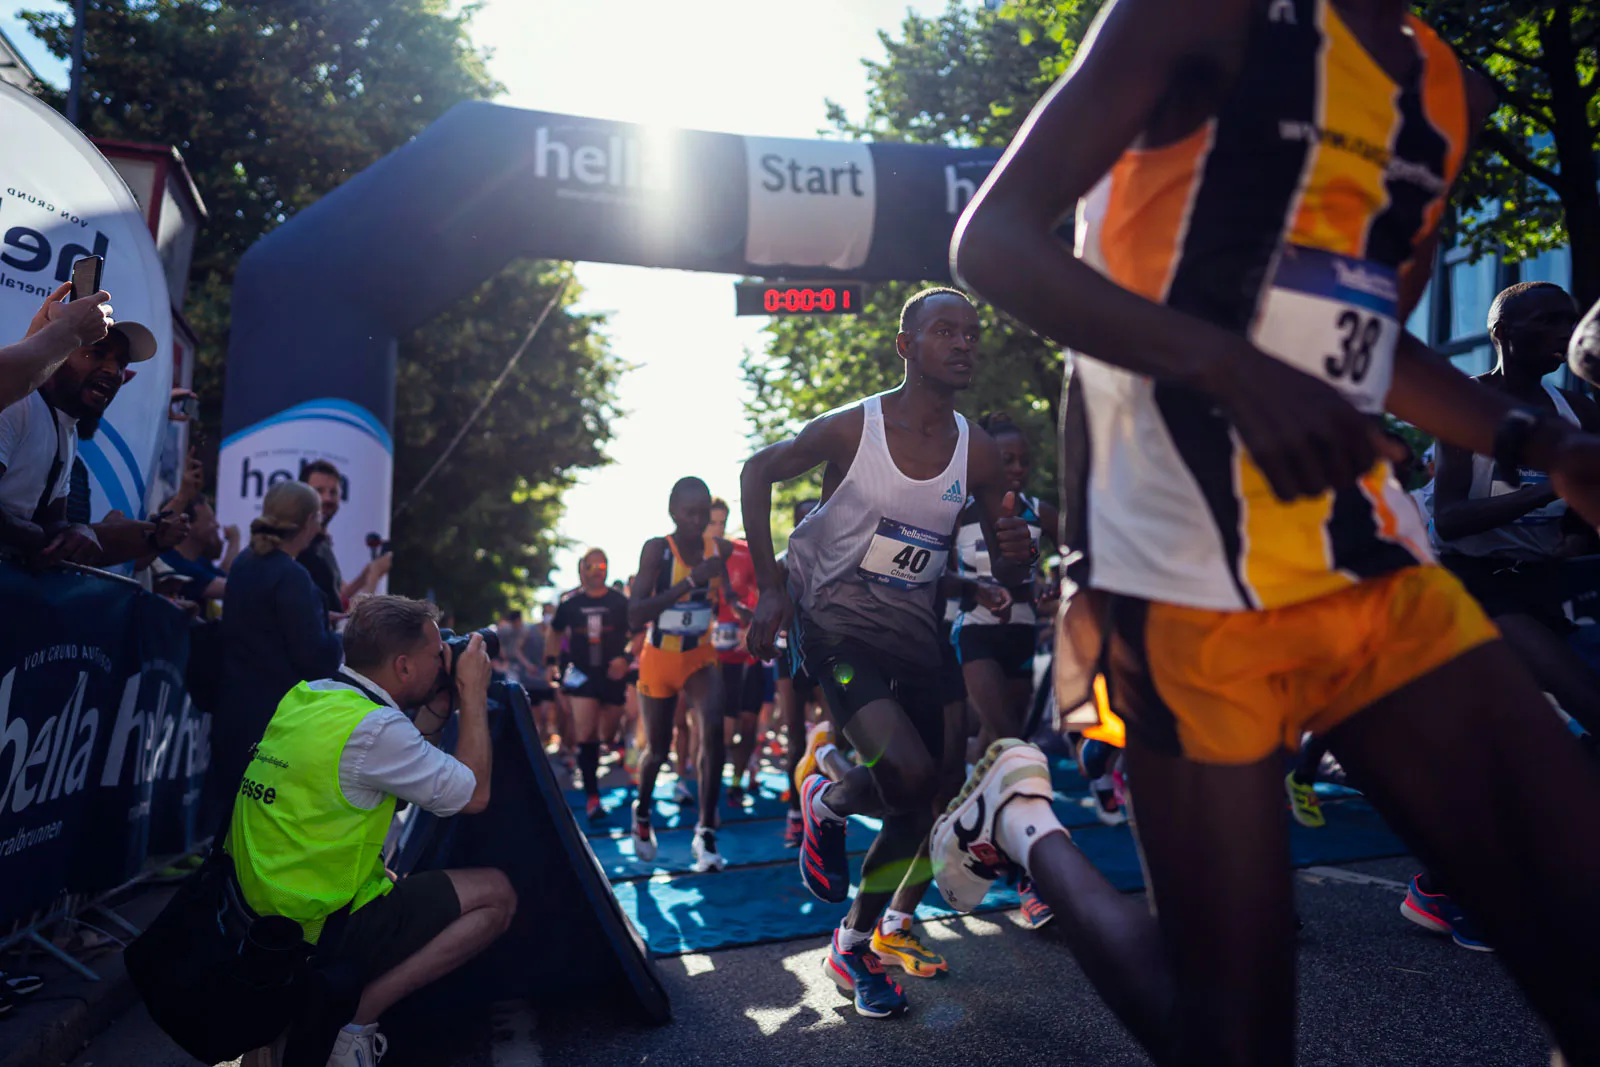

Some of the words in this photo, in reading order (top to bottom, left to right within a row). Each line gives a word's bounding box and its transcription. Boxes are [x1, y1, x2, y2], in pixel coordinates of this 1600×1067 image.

[534, 126, 670, 190] hell
[760, 153, 864, 197] Start
[764, 287, 850, 312] 0:00:01
[1324, 310, 1382, 384] 38
[901, 526, 921, 540] hella
[892, 545, 931, 574] 40
[890, 569, 917, 581] Charles
[682, 611, 693, 626] 8
[24, 649, 46, 672] VON
[0, 667, 99, 814] hella
[0, 820, 63, 857] ralbrunnen
